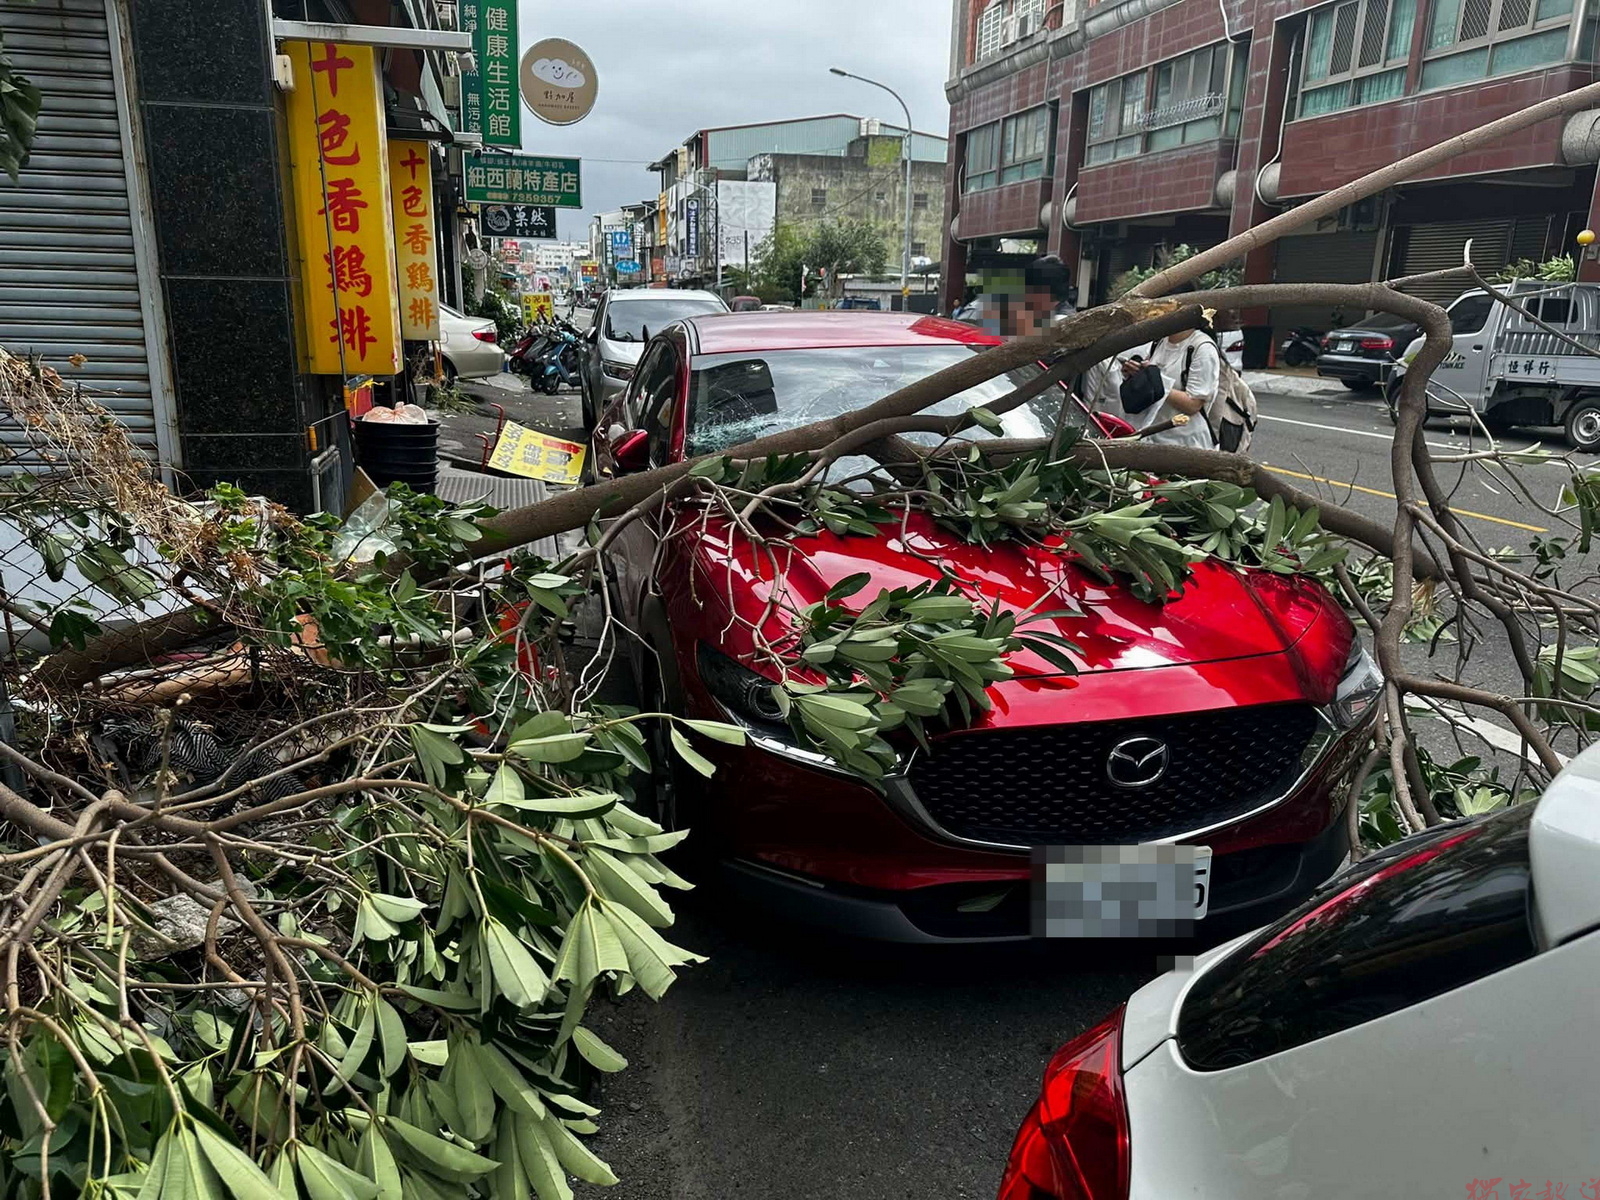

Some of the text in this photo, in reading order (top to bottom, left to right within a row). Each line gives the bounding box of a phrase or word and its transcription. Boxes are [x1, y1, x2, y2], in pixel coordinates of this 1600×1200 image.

[485, 6, 511, 137] 健康生活館
[468, 166, 577, 193] 紐西蘭特產店
